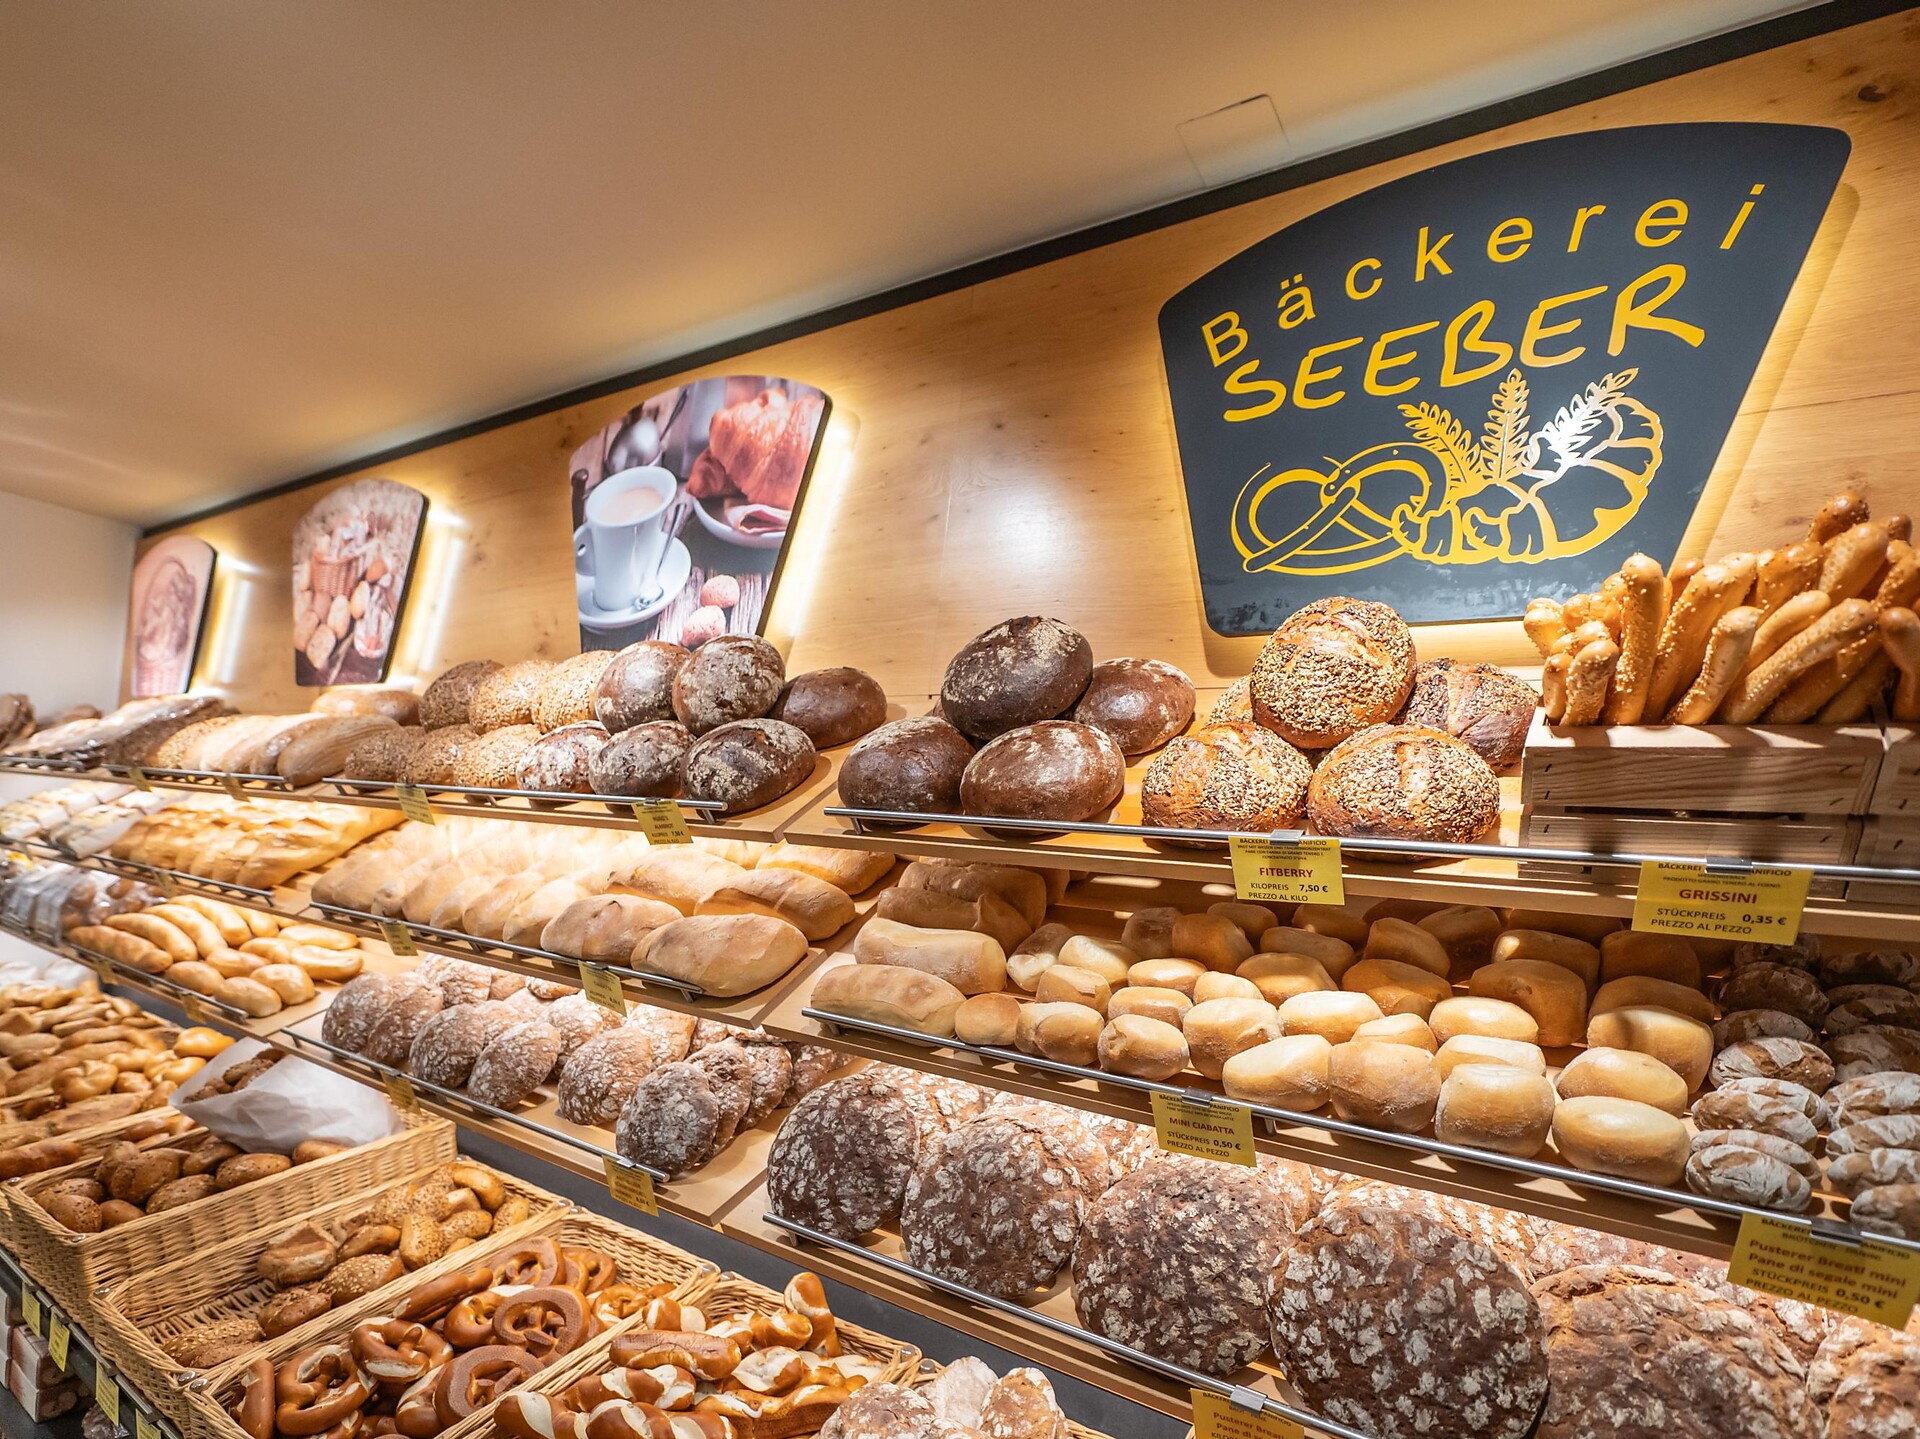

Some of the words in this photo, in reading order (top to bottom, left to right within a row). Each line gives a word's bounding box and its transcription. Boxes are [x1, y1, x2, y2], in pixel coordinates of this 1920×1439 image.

[1202, 184, 1764, 367] Bäckerei
[1223, 263, 1705, 422] SEEBER
[1259, 867, 1313, 878] FITBERRY
[1658, 863, 1702, 871] BÄCKEREI
[1751, 868, 1792, 877] ANIFICIO
[1251, 882, 1289, 891] KILOPREIS
[1299, 884, 1319, 893] 7,50
[1249, 892, 1277, 900] PREZZO
[1679, 888, 1758, 904] GRISSINI
[1657, 907, 1727, 920] STÜCKPREIS
[1741, 914, 1774, 925] 0,35
[1778, 917, 1787, 925] €
[1651, 919, 1694, 929] PREZZO
[1714, 925, 1752, 934] PEZZO
[1169, 1118, 1190, 1126] MINI
[1192, 1122, 1234, 1135] CIABATTA
[1167, 1131, 1209, 1144] STÜCKPREIS
[1213, 1140, 1233, 1149] 0,50
[1167, 1141, 1194, 1149] PREZZO
[1206, 1148, 1229, 1156] PEZZO
